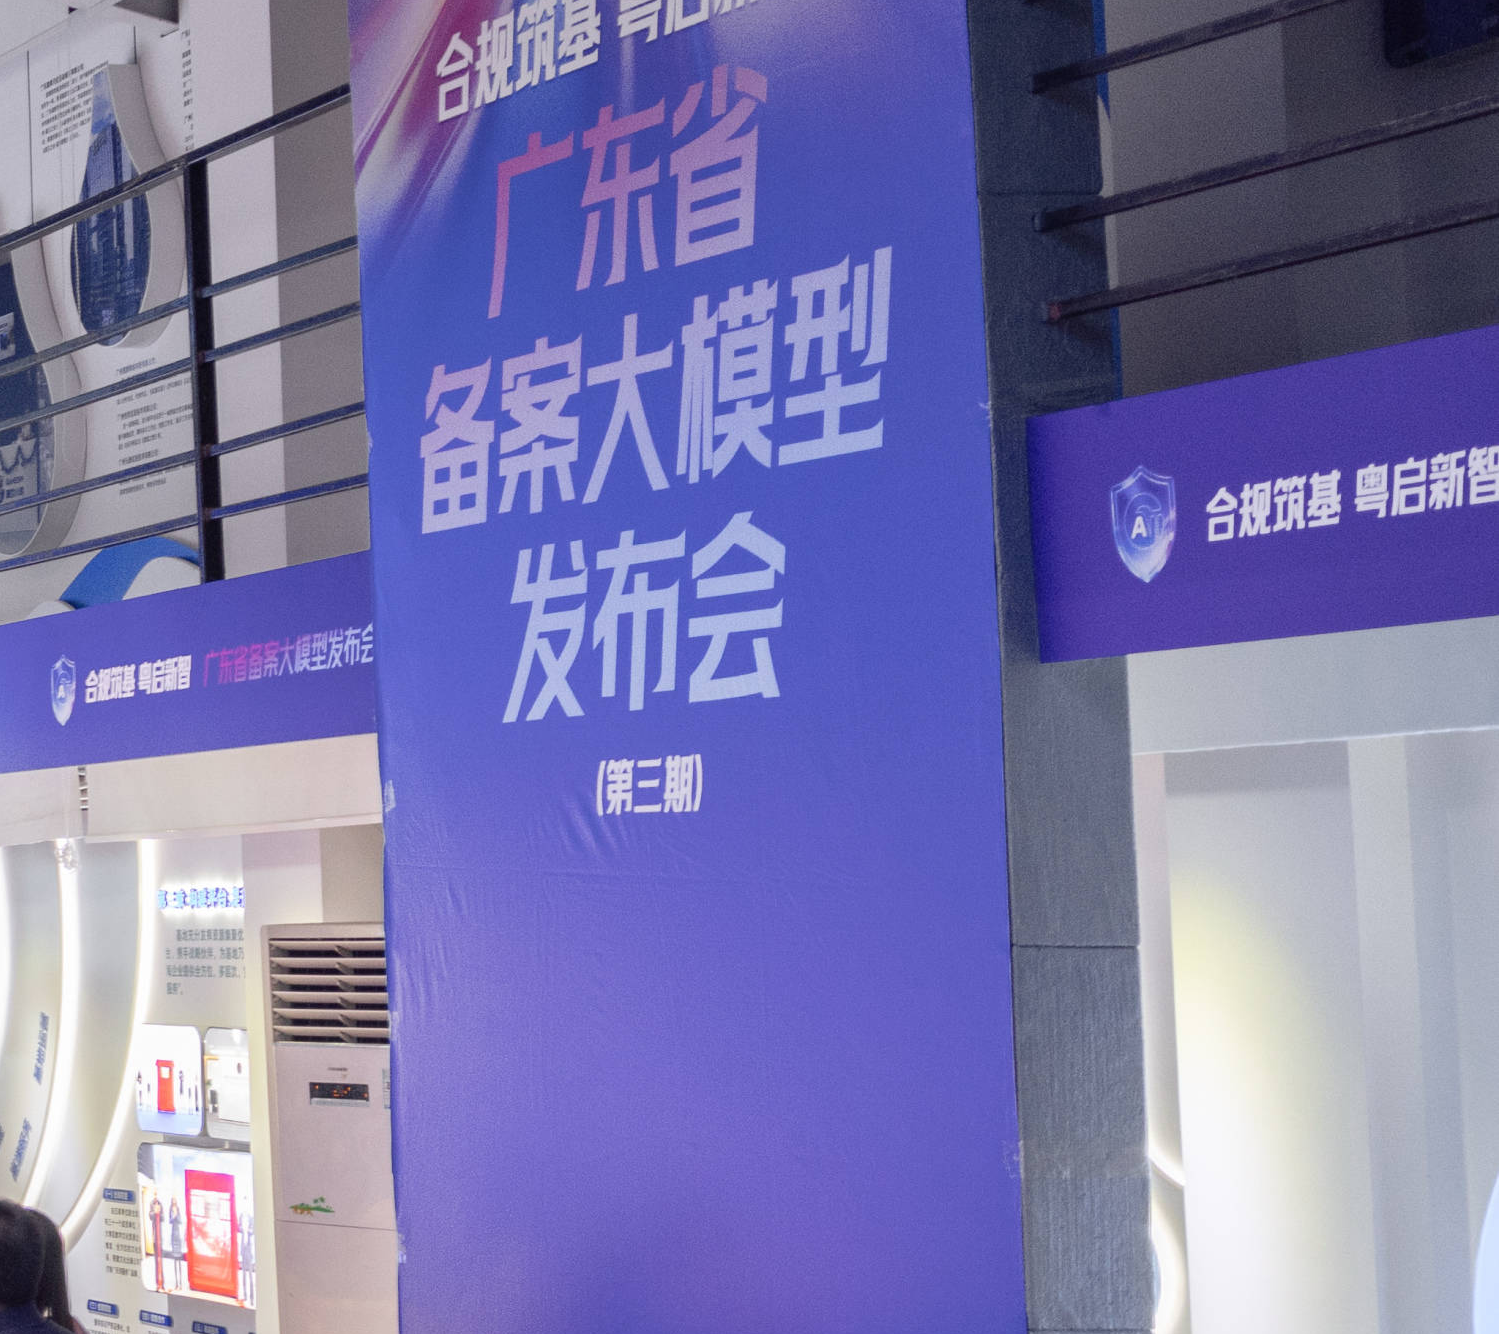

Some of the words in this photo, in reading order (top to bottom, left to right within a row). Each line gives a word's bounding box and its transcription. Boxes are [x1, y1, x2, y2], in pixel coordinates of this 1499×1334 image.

[486, 63, 769, 321] 广东省
[419, 245, 894, 536] 备案大模型
[1205, 468, 1342, 543] 合规筑基
[85, 663, 136, 706] 合规筑基
[137, 654, 192, 698] 粤启新智
[501, 509, 787, 725] 发布会
